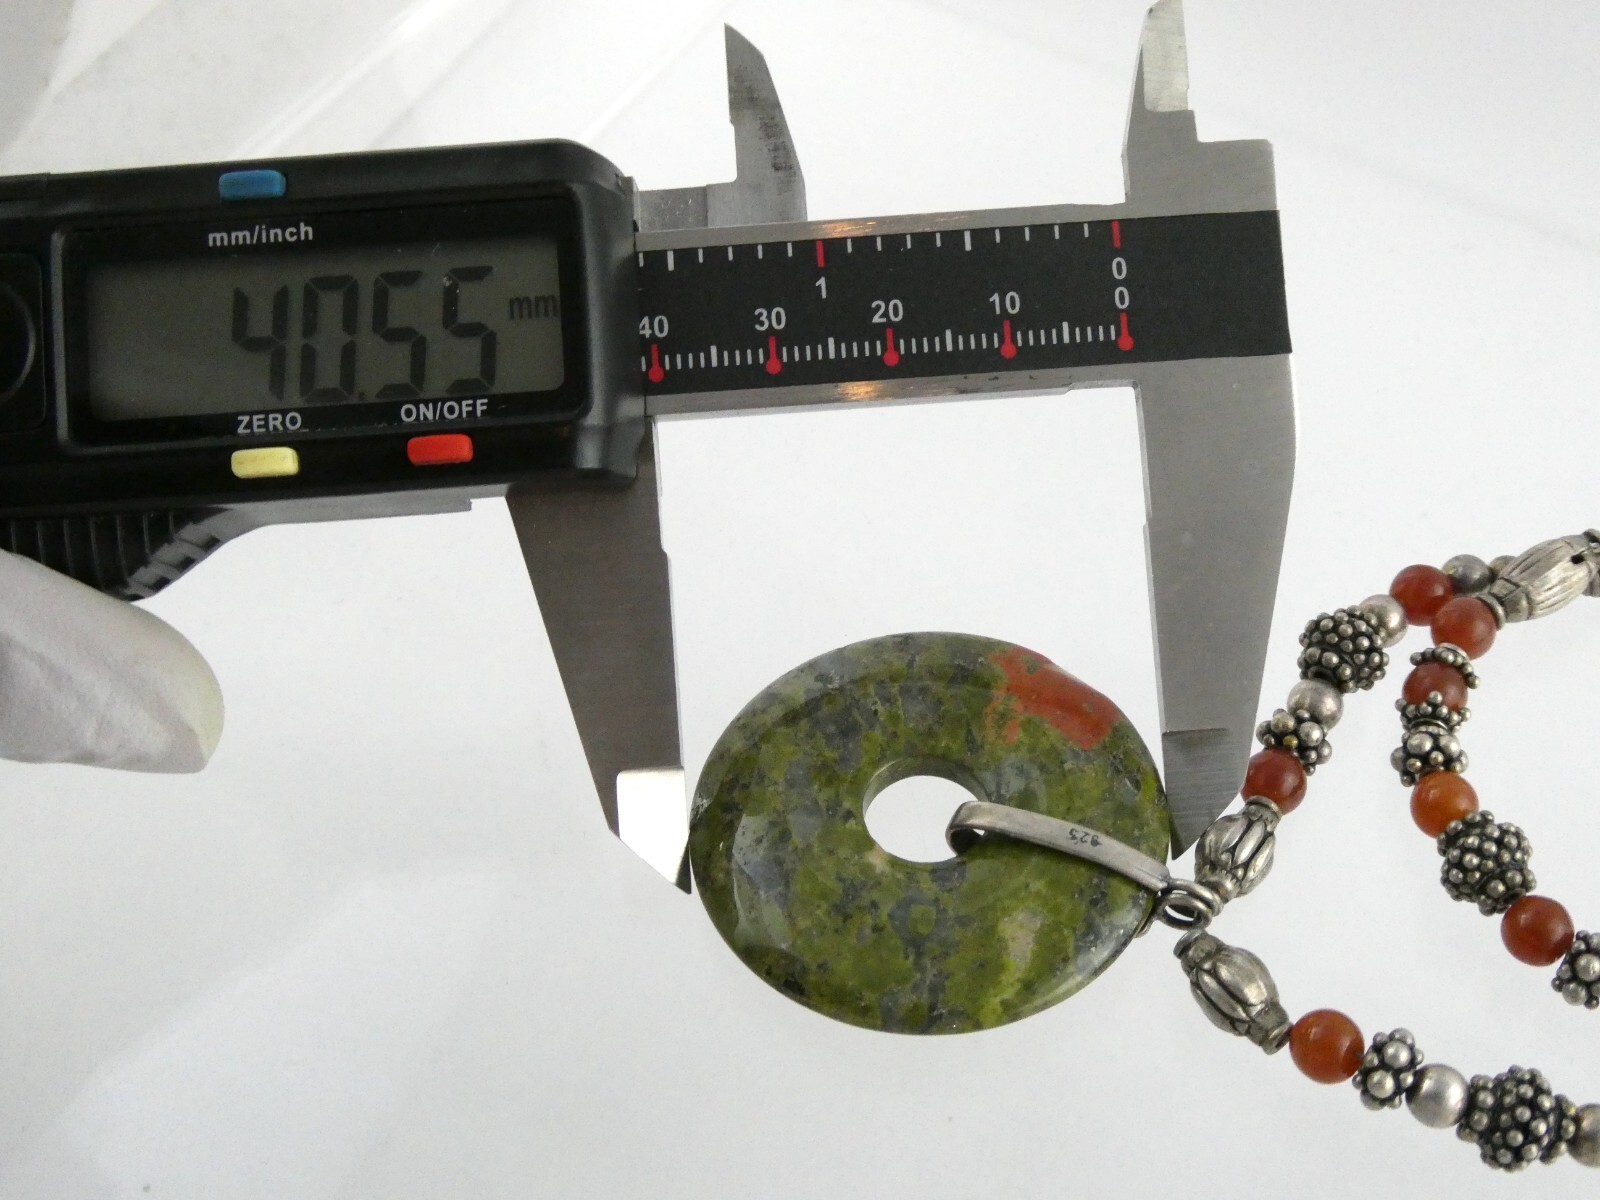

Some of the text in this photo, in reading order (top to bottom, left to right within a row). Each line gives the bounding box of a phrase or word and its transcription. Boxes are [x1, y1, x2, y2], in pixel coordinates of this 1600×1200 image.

[208, 222, 314, 248] mm/inch
[815, 256, 1128, 299] 1 0
[638, 286, 1130, 339] 40 30 20 10 0
[230, 265, 559, 401] 40.55 mm
[236, 411, 303, 434] ZERO
[400, 398, 489, 423] ON/OFF
